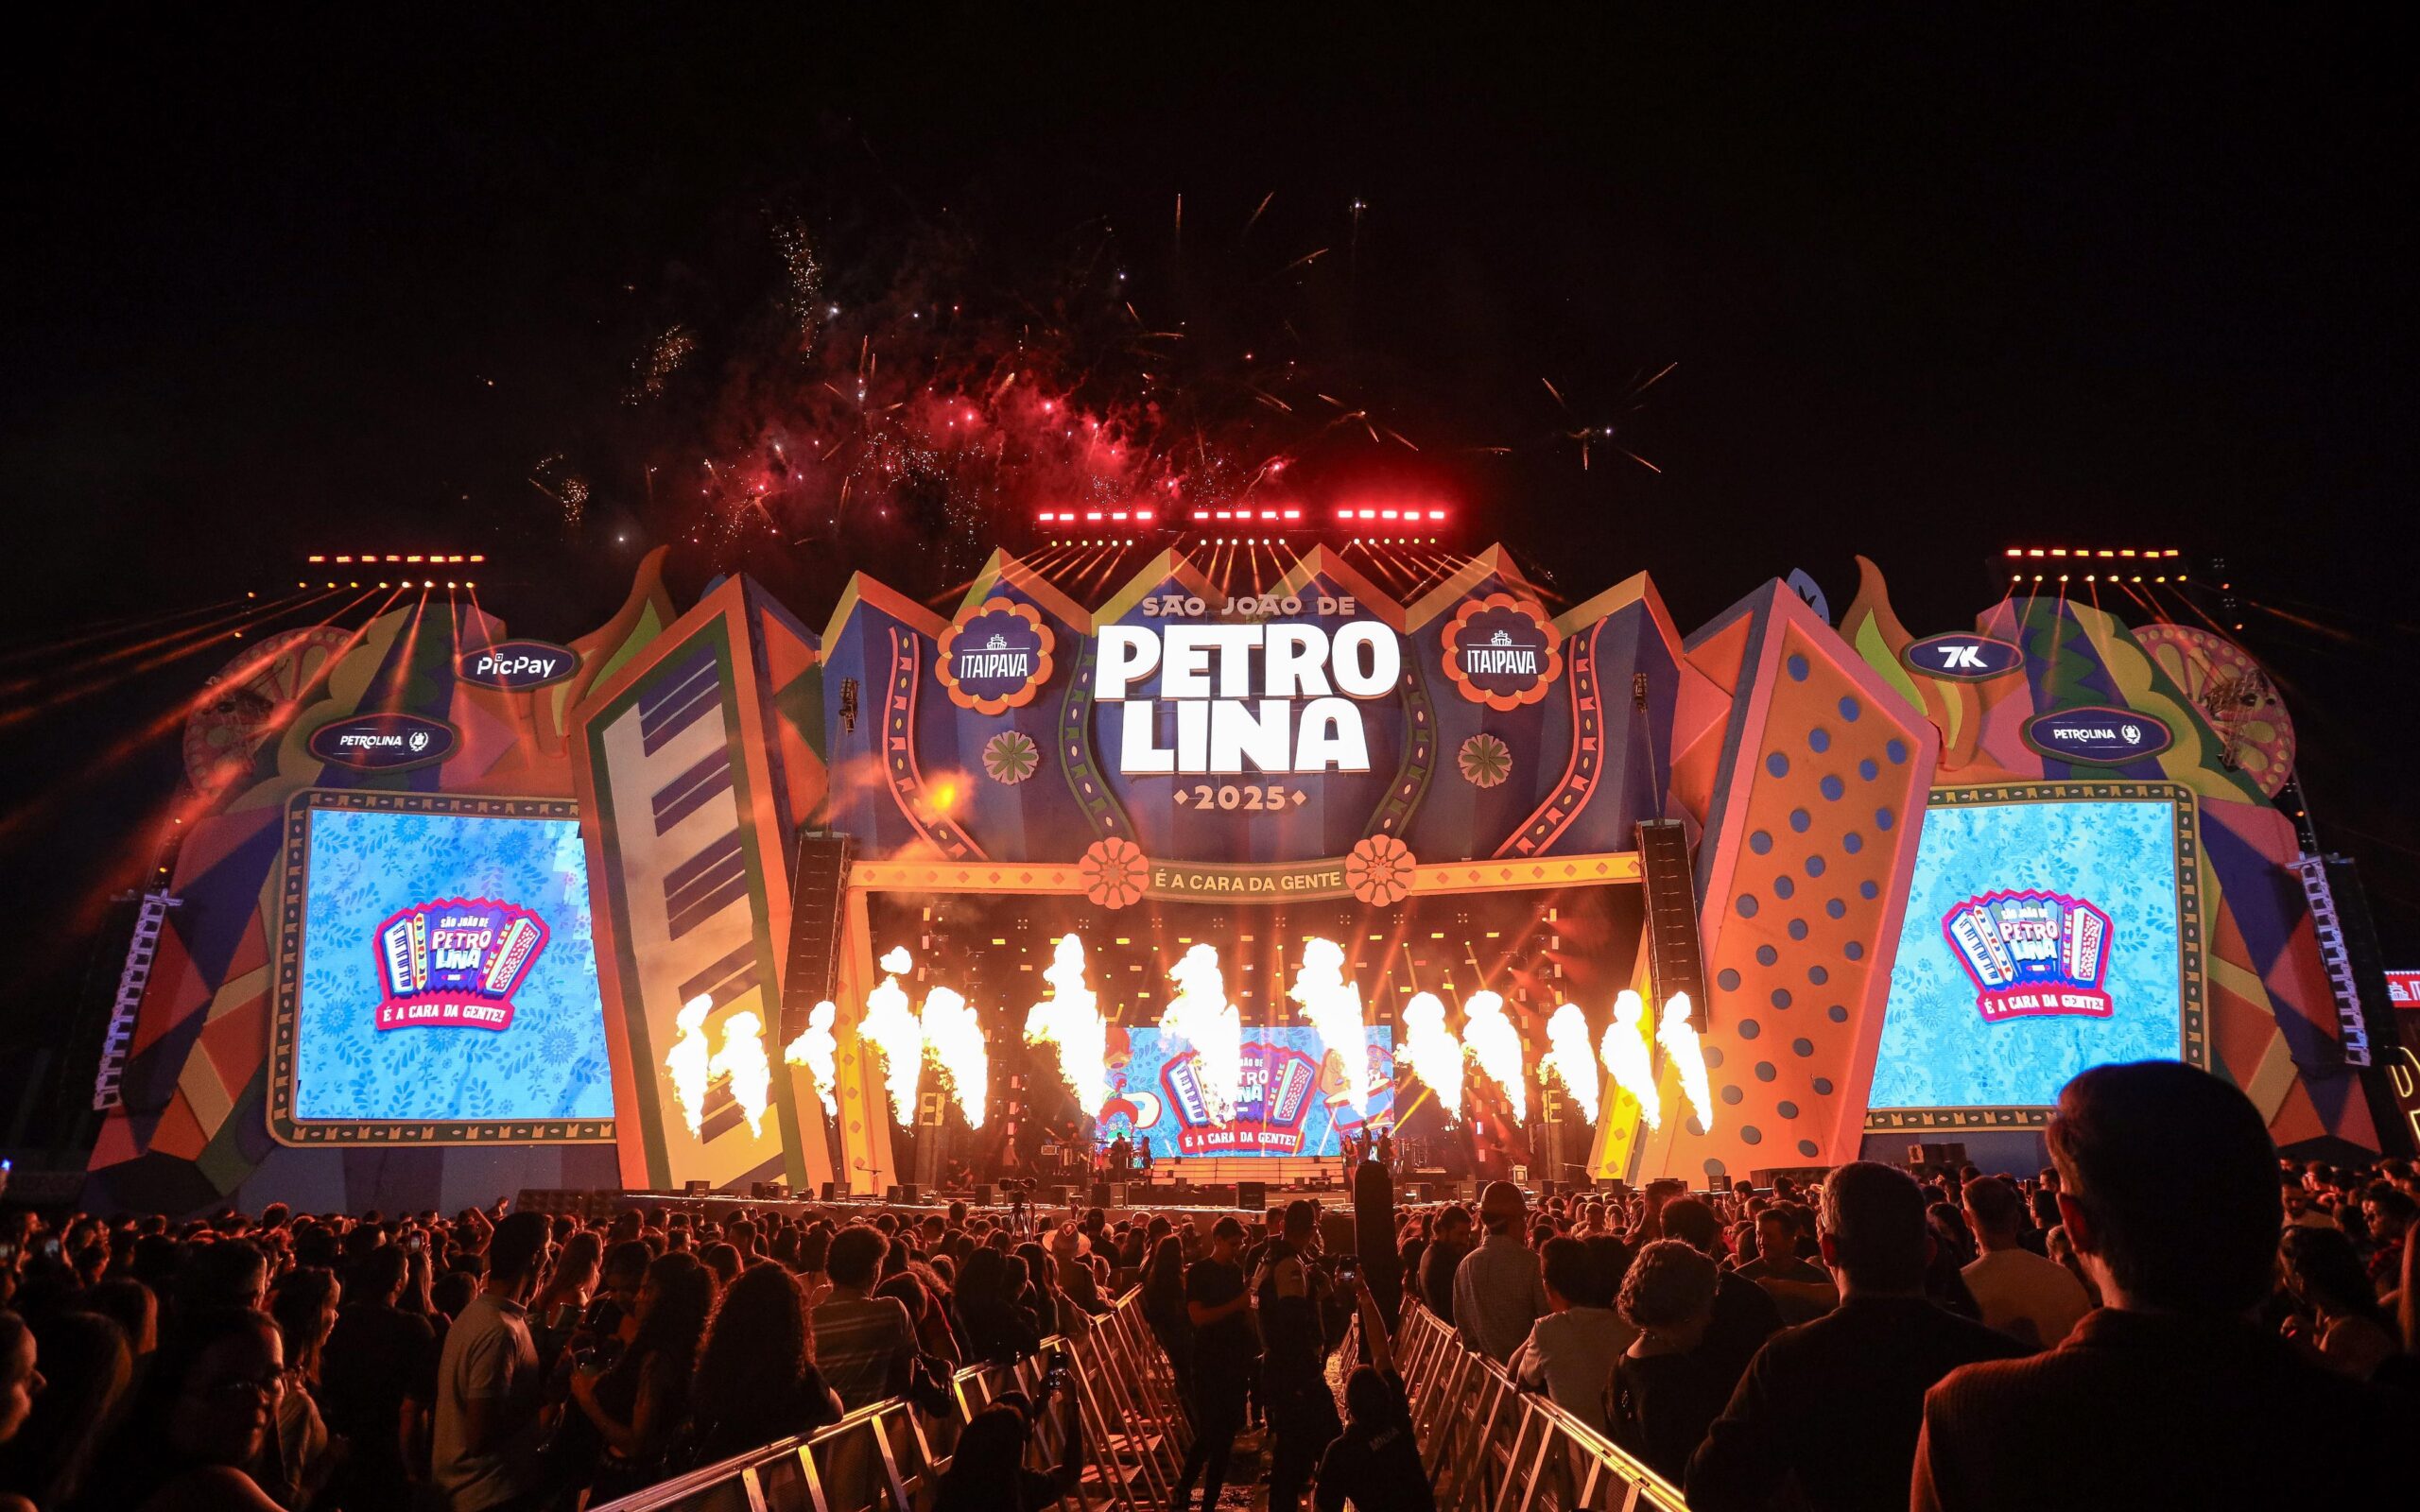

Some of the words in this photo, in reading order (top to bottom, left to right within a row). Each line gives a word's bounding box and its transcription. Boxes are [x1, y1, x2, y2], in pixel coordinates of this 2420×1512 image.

[1142, 594, 1206, 616] SÃO
[1222, 593, 1303, 616] JOÃO
[1318, 596, 1356, 616] DE
[476, 653, 556, 678] PicPay
[959, 653, 1028, 679] ITAIPAVA
[1095, 620, 1401, 702] PETRO
[1467, 650, 1537, 674] ITAIPAVA
[1938, 645, 1988, 668] 7K
[339, 735, 403, 749] PETROLINA
[1120, 696, 1371, 774] LINA
[2053, 729, 2117, 743] PETROLINA
[1194, 785, 1286, 810] 2025
[1154, 868, 1167, 887] É
[1170, 873, 1184, 889] A
[1189, 874, 1245, 892] CARA
[1249, 877, 1276, 892] DA
[1280, 871, 1341, 890] GENTE
[431, 930, 493, 950] PETRO
[1998, 920, 2059, 942] PETRO
[435, 948, 481, 970] LINA
[383, 1006, 392, 1022] É
[395, 1007, 404, 1020] A
[408, 1005, 439, 1018] CARA
[443, 1004, 459, 1017] DA
[462, 1005, 506, 1022] GENTE!
[1984, 998, 1995, 1014] É
[1997, 999, 2007, 1012] A
[2008, 995, 2040, 1009] CARA
[2042, 994, 2059, 1007] DA
[2061, 994, 2104, 1010] GENTE!
[1184, 1134, 1193, 1147] É
[1197, 1135, 1204, 1145] A
[1207, 1132, 1235, 1144] CARA
[1239, 1131, 1253, 1143] DA
[1257, 1132, 1297, 1146] GENTE!
